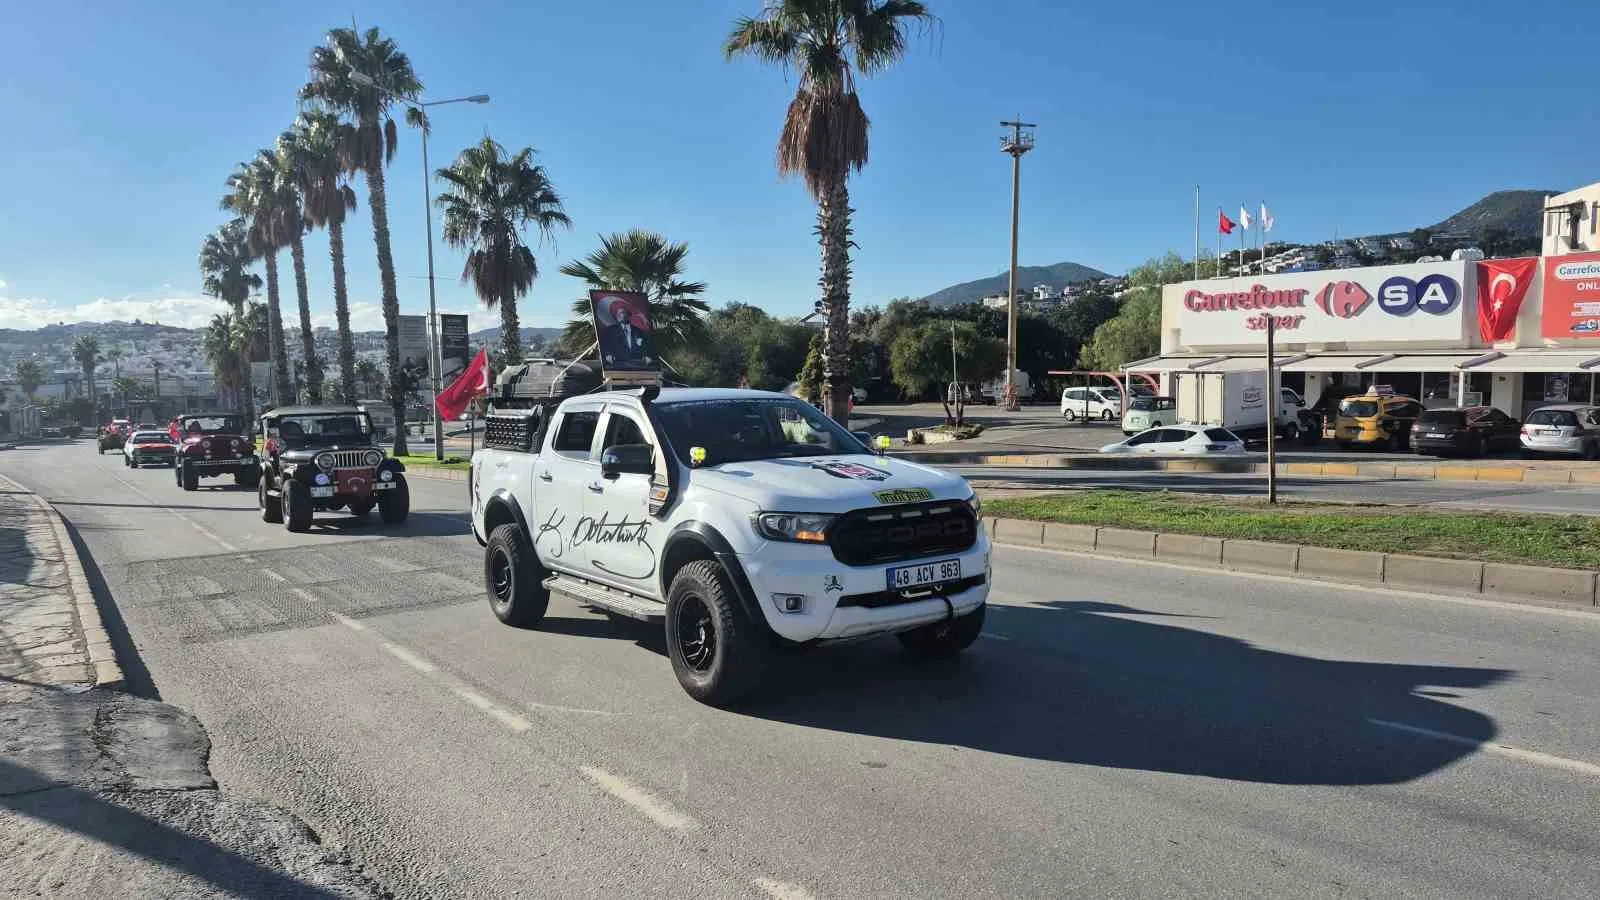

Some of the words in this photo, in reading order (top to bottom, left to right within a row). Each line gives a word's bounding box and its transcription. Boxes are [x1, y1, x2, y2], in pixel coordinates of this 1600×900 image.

[1184, 283, 1309, 312] Carrefour
[896, 569, 910, 585] 48
[916, 563, 935, 584] ACV
[940, 562, 959, 579] 963
